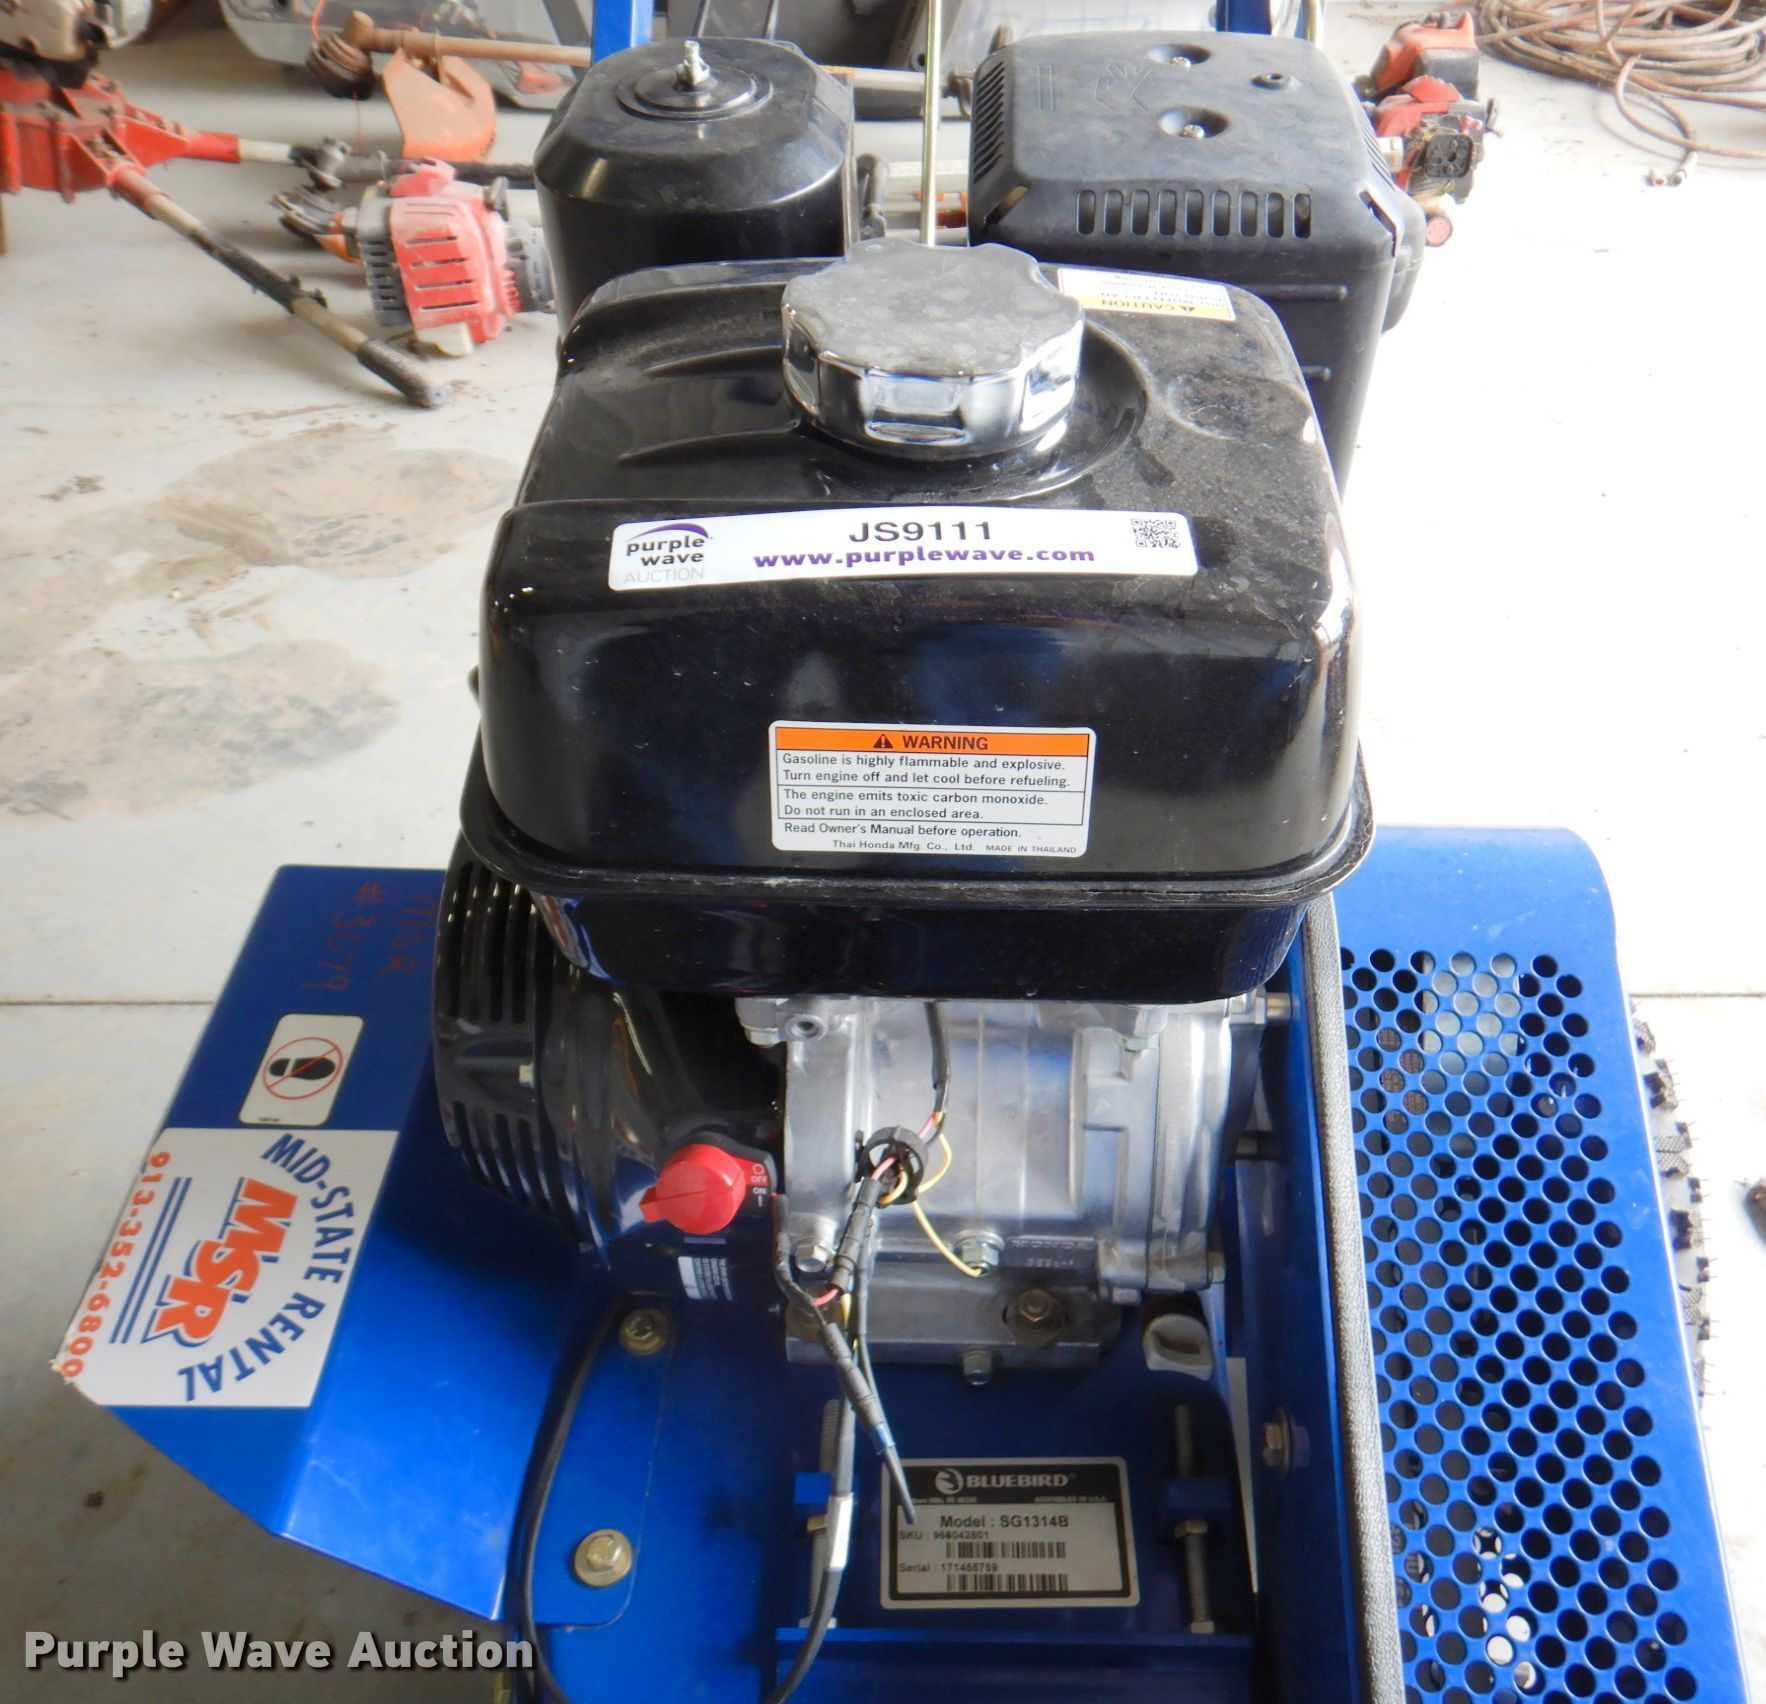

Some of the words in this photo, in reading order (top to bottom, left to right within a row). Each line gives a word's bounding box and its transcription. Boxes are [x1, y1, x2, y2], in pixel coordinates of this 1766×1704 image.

[1102, 299, 1175, 311] CAUTION
[849, 521, 991, 543] JS9111
[626, 535, 705, 556] purple
[640, 552, 704, 566] wave
[754, 546, 1095, 567] www.purplewave.com
[624, 567, 704, 585] AUCTION
[902, 735, 988, 750] WARNING
[783, 753, 837, 765] Gasoline
[842, 754, 851, 765] is
[856, 755, 895, 768] highly
[899, 756, 969, 768] flammable
[973, 759, 997, 769] and
[1001, 760, 1065, 772] explosive.
[783, 769, 811, 780] Turn
[815, 771, 858, 784] engine
[863, 771, 880, 782] off
[885, 773, 908, 783] and
[912, 773, 929, 783] let
[933, 774, 960, 784] cool
[964, 774, 1006, 785] before
[1010, 775, 1070, 788] refueling.
[784, 788, 807, 799] The
[812, 790, 854, 802] engine
[858, 790, 893, 801] emits
[897, 791, 928, 802] toxic
[932, 792, 977, 804] carbon
[982, 793, 1048, 805] monoxide.
[784, 805, 801, 815] Do
[805, 806, 826, 816] not
[830, 808, 850, 816] run
[854, 806, 865, 816] in
[870, 808, 886, 817] an
[890, 807, 947, 818] enclosed
[951, 810, 983, 819] area.
[784, 822, 815, 833] Read
[819, 823, 867, 834] Owner's
[870, 824, 914, 835] Manual
[918, 825, 957, 836] before
[961, 826, 1021, 838] operation.
[832, 840, 856, 849] Thai
[859, 840, 895, 850] Honda
[1031, 846, 1077, 854] THAILAND
[752, 1187, 768, 1195] ON
[260, 1133, 355, 1284] MID-STATE
[60, 1151, 171, 1379] 913-352-6800
[145, 1176, 299, 1345] MSR
[178, 1292, 327, 1402] RENTAL
[940, 1515, 986, 1528] Model
[999, 1515, 1069, 1528] SG1314B
[899, 1531, 923, 1540] SKU
[899, 1563, 931, 1573] Serial
